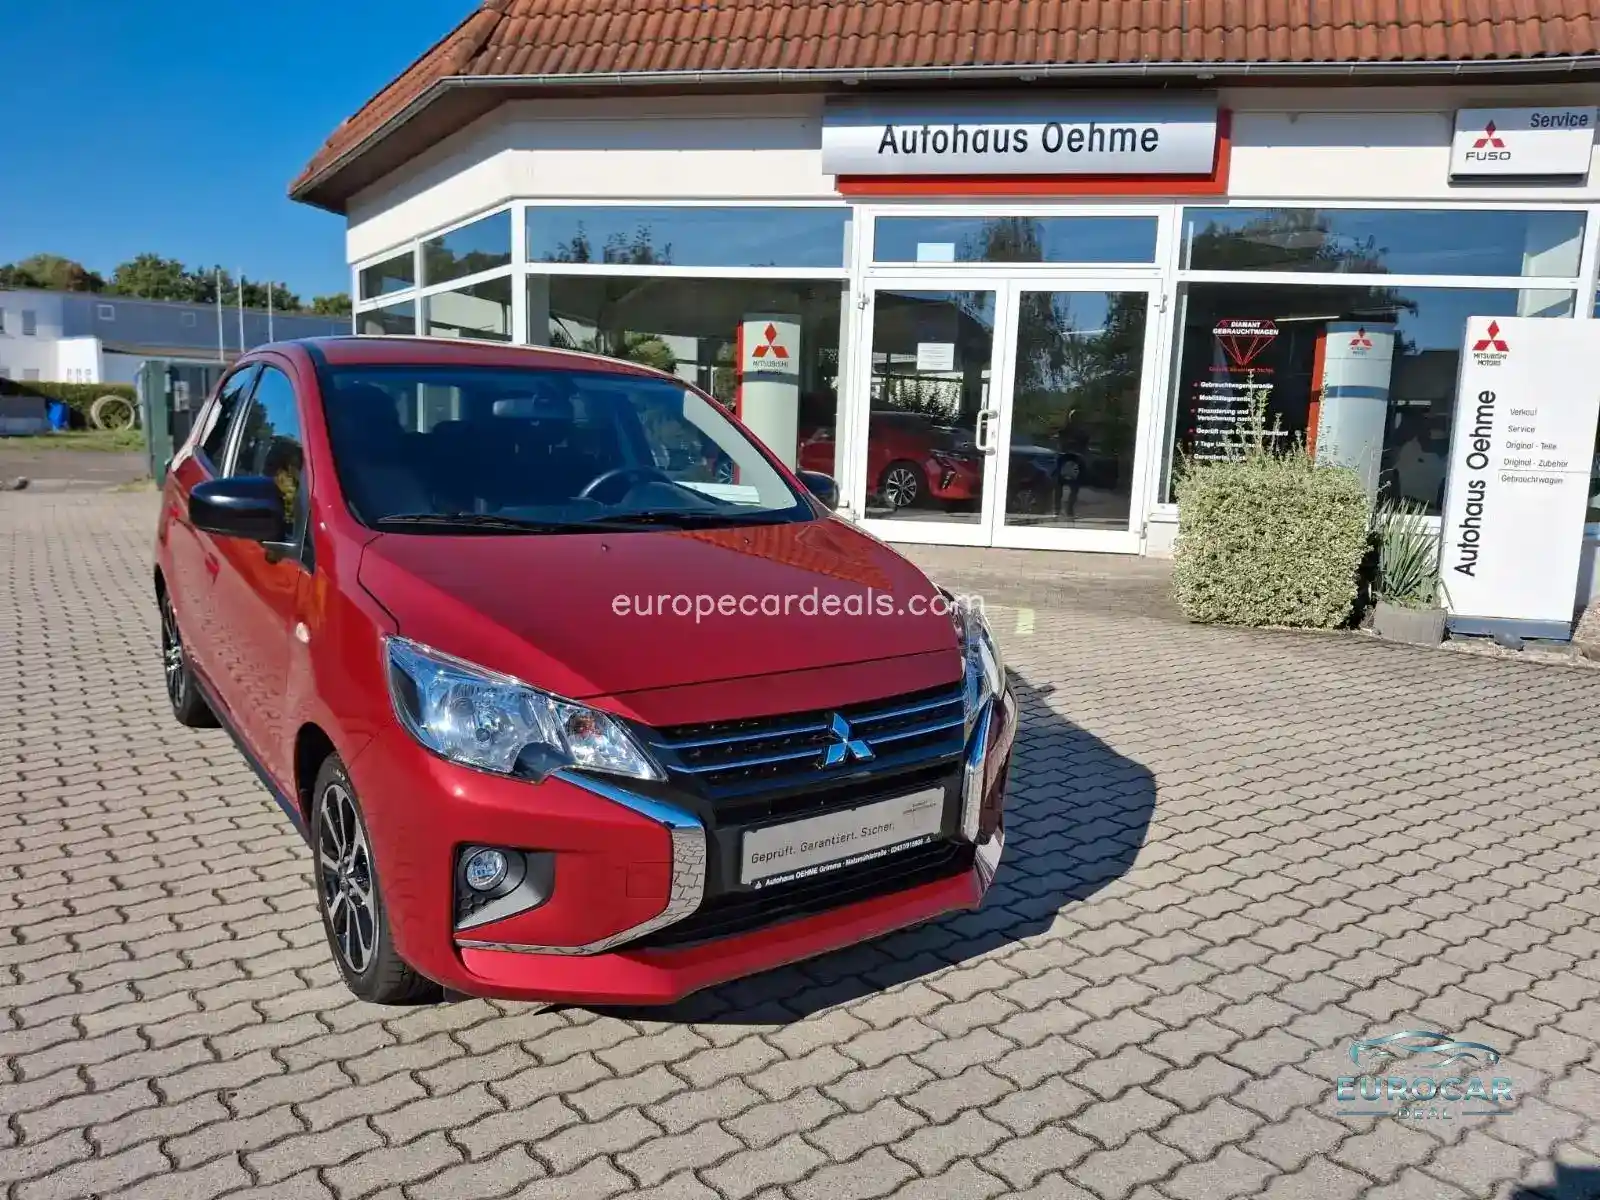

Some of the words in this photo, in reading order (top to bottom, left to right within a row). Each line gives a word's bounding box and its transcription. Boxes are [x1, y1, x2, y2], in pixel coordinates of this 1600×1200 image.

[1530, 112, 1588, 128] Service
[878, 123, 1029, 154] Autohaus
[1041, 122, 1160, 153] Oehme
[1465, 151, 1512, 162] FUSO
[1212, 328, 1279, 336] GEBRAUCHTWAGEN
[1466, 390, 1496, 470] Oehme
[1508, 425, 1536, 433] Service
[1505, 441, 1533, 450] Original
[1503, 458, 1532, 467] Original
[1454, 478, 1486, 577] Autohaus
[751, 845, 796, 864] Geprüft.
[800, 831, 858, 853] Garantiert.
[765, 874, 795, 887] Autohaus
[795, 867, 818, 880] OEHME
[819, 862, 842, 873] Grimma
